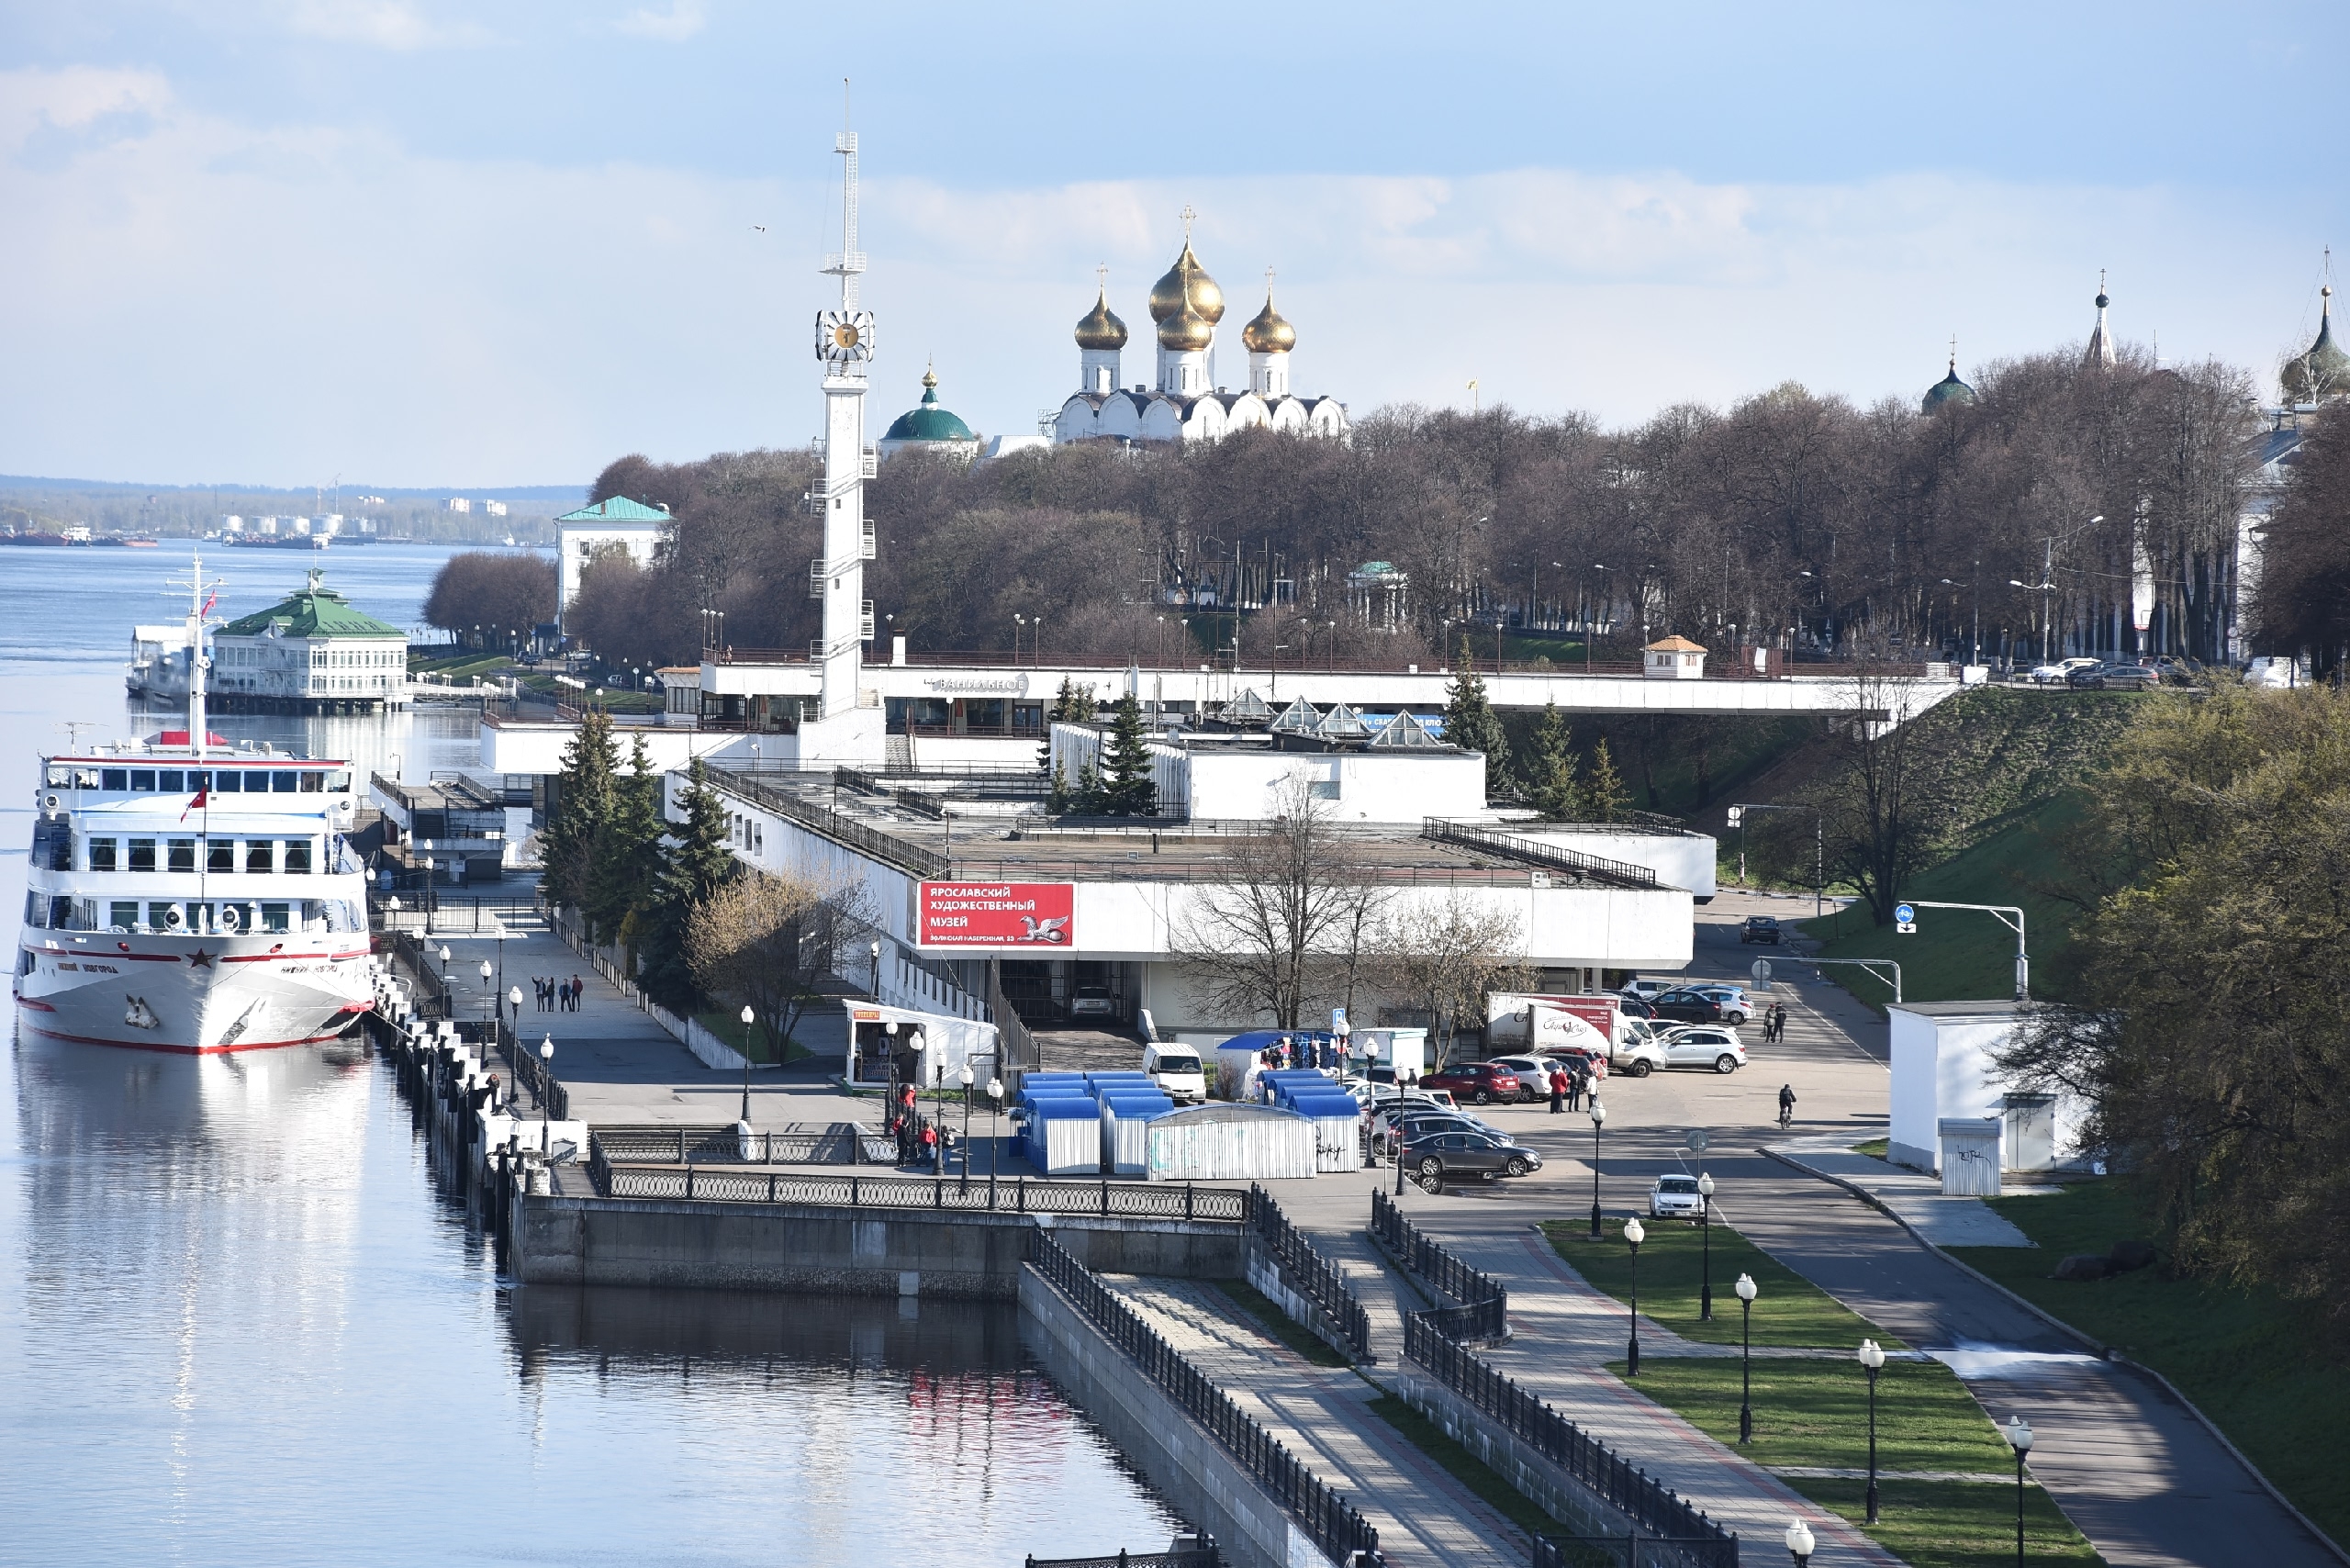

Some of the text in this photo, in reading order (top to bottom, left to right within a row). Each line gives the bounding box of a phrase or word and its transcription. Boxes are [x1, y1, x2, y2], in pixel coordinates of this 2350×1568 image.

[940, 678, 1024, 690] ВАНИЛЬНОЕ
[930, 886, 1011, 898] ЯРОСЛАВСКИЙ
[930, 900, 1035, 912] ХУДОЖЕСТВЕННЫЙ
[930, 916, 968, 927] МУЗЕЙ
[82, 964, 118, 974] НОВГОРОД
